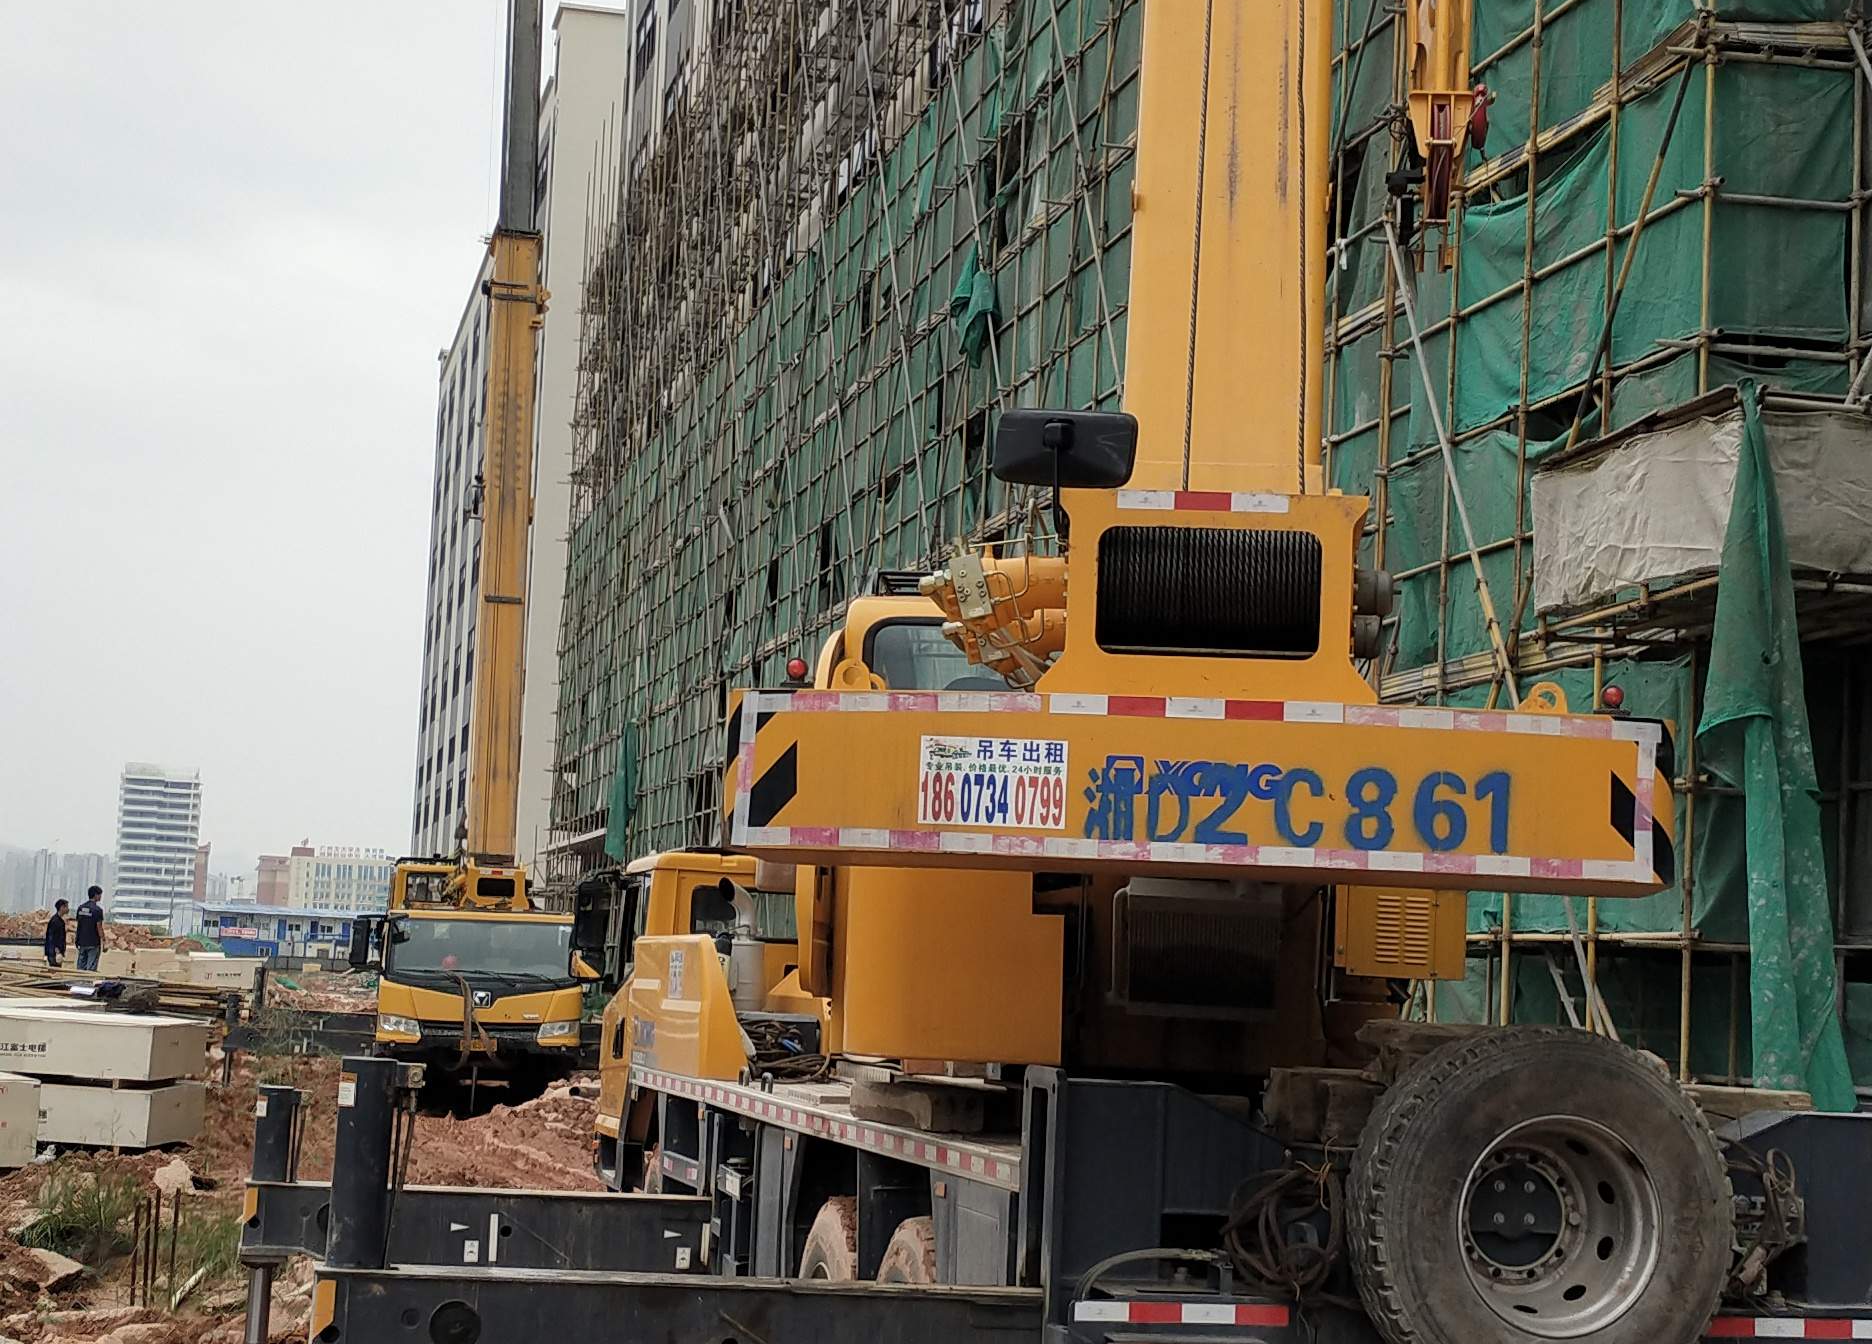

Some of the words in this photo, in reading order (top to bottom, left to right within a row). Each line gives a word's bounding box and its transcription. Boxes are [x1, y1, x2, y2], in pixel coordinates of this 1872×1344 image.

[976, 739, 1064, 764] 吊车出租
[921, 771, 955, 822] 186
[960, 772, 1009, 824] 0734
[1015, 775, 1064, 826] 0799
